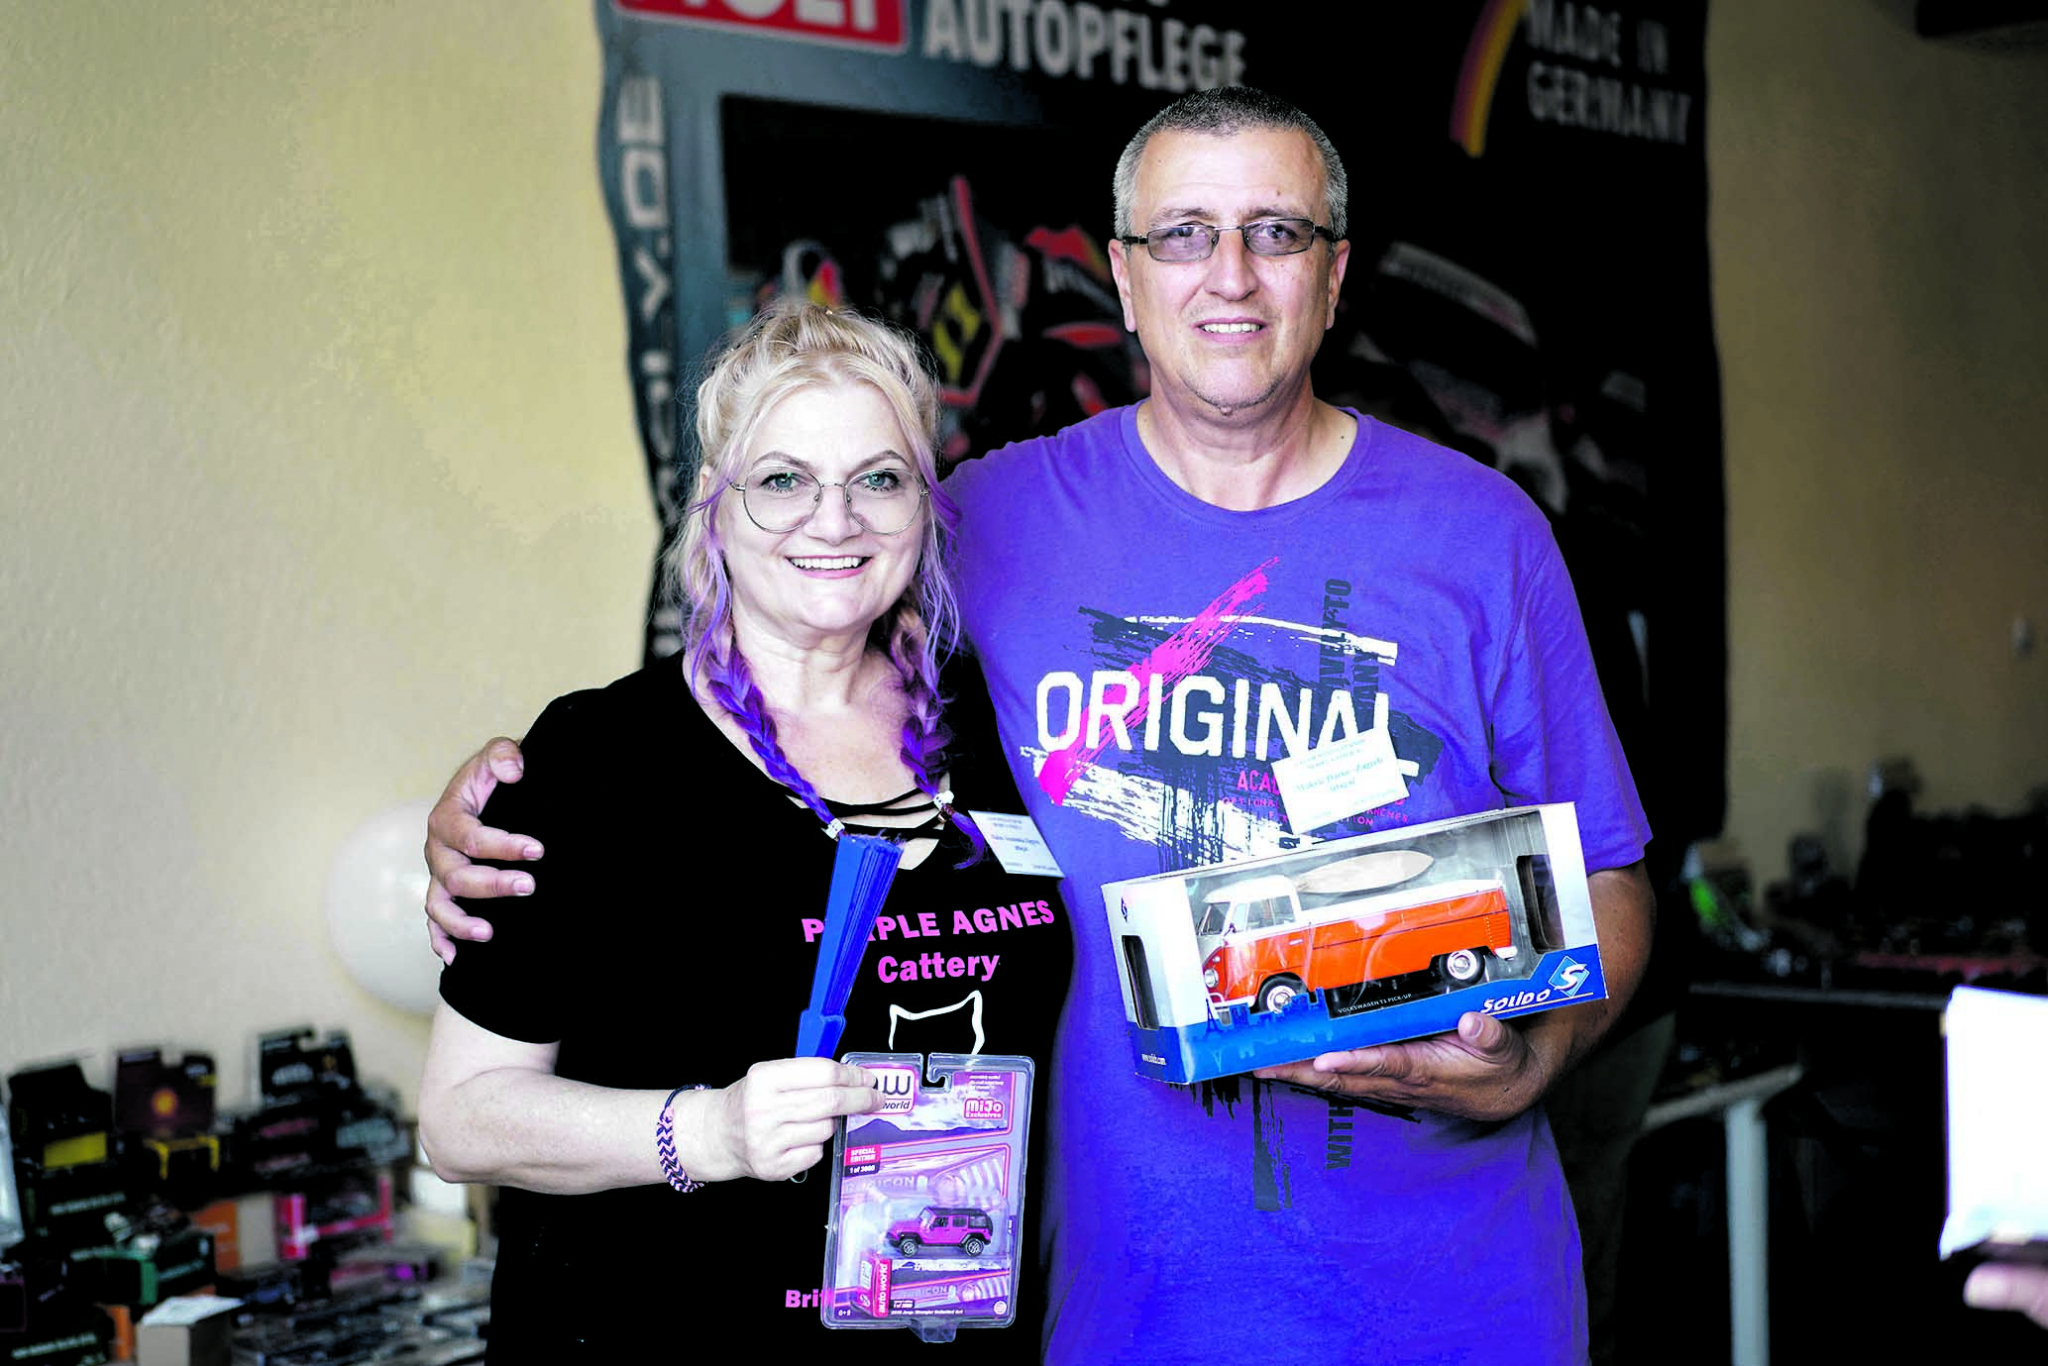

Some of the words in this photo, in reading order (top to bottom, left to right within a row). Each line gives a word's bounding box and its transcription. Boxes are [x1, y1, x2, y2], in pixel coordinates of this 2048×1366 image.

[923, 0, 1245, 93] AUTOPFLEGE
[1527, 0, 1623, 69] MADE
[1636, 18, 1669, 75] IN
[1526, 60, 1692, 146] GERMANY
[801, 912, 942, 943] PPLE
[953, 899, 1056, 936] AGNES
[877, 951, 1001, 984] Cattery
[1337, 1000, 1380, 1014] VOLKSWAGEN
[1387, 993, 1412, 1004] PICK-UP
[1480, 988, 1552, 1014] SOLIDO
[1325, 1098, 1354, 1171] WITH
